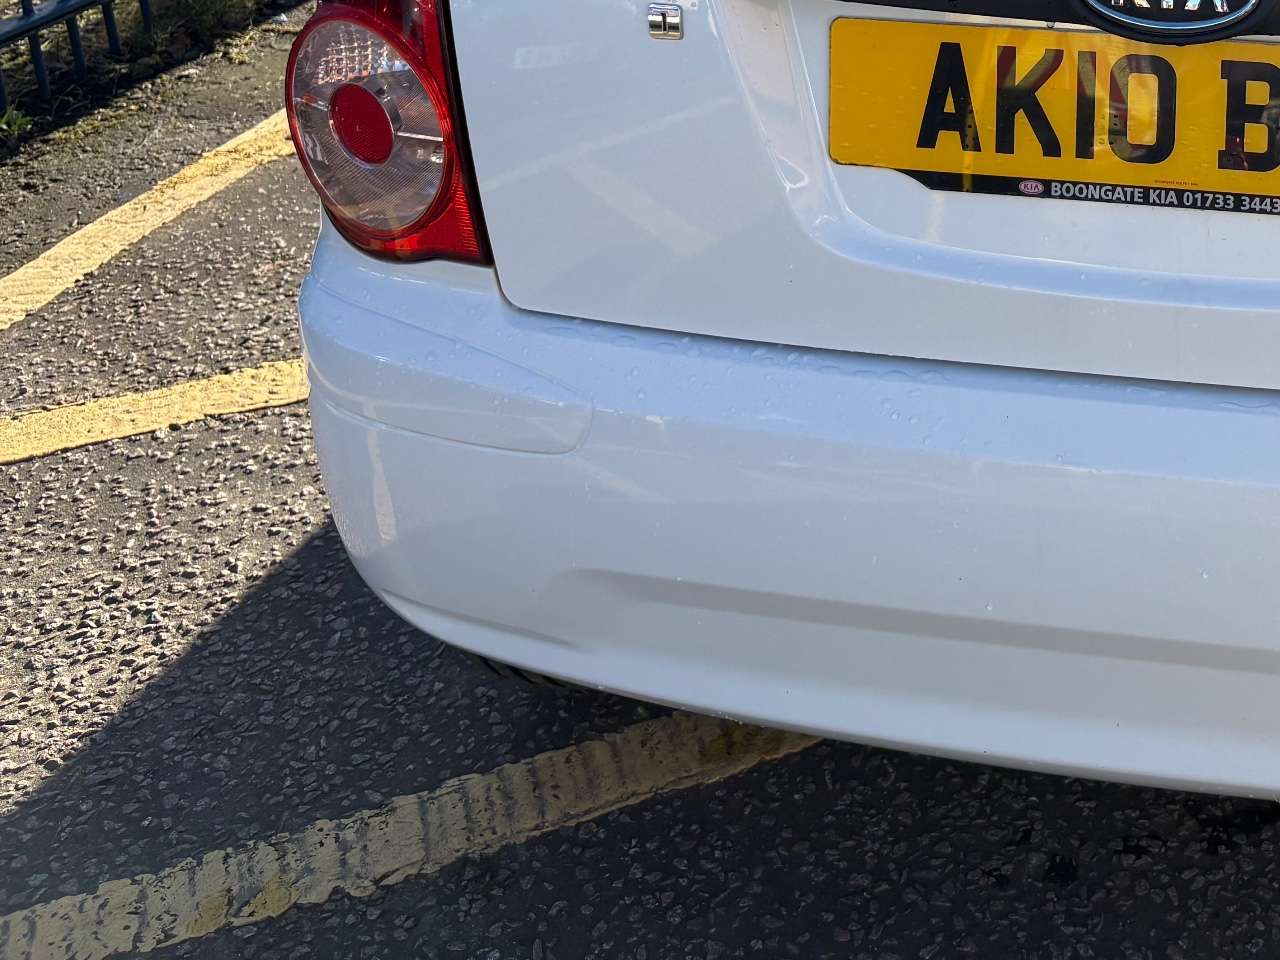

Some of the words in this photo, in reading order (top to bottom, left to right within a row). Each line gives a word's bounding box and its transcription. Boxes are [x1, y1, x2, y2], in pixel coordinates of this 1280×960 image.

[916, 41, 1177, 164] AK10
[1023, 182, 1042, 192] KIA
[1050, 182, 1144, 203] BOONGATE
[1149, 189, 1178, 206] KIA
[1183, 191, 1235, 209] 01733
